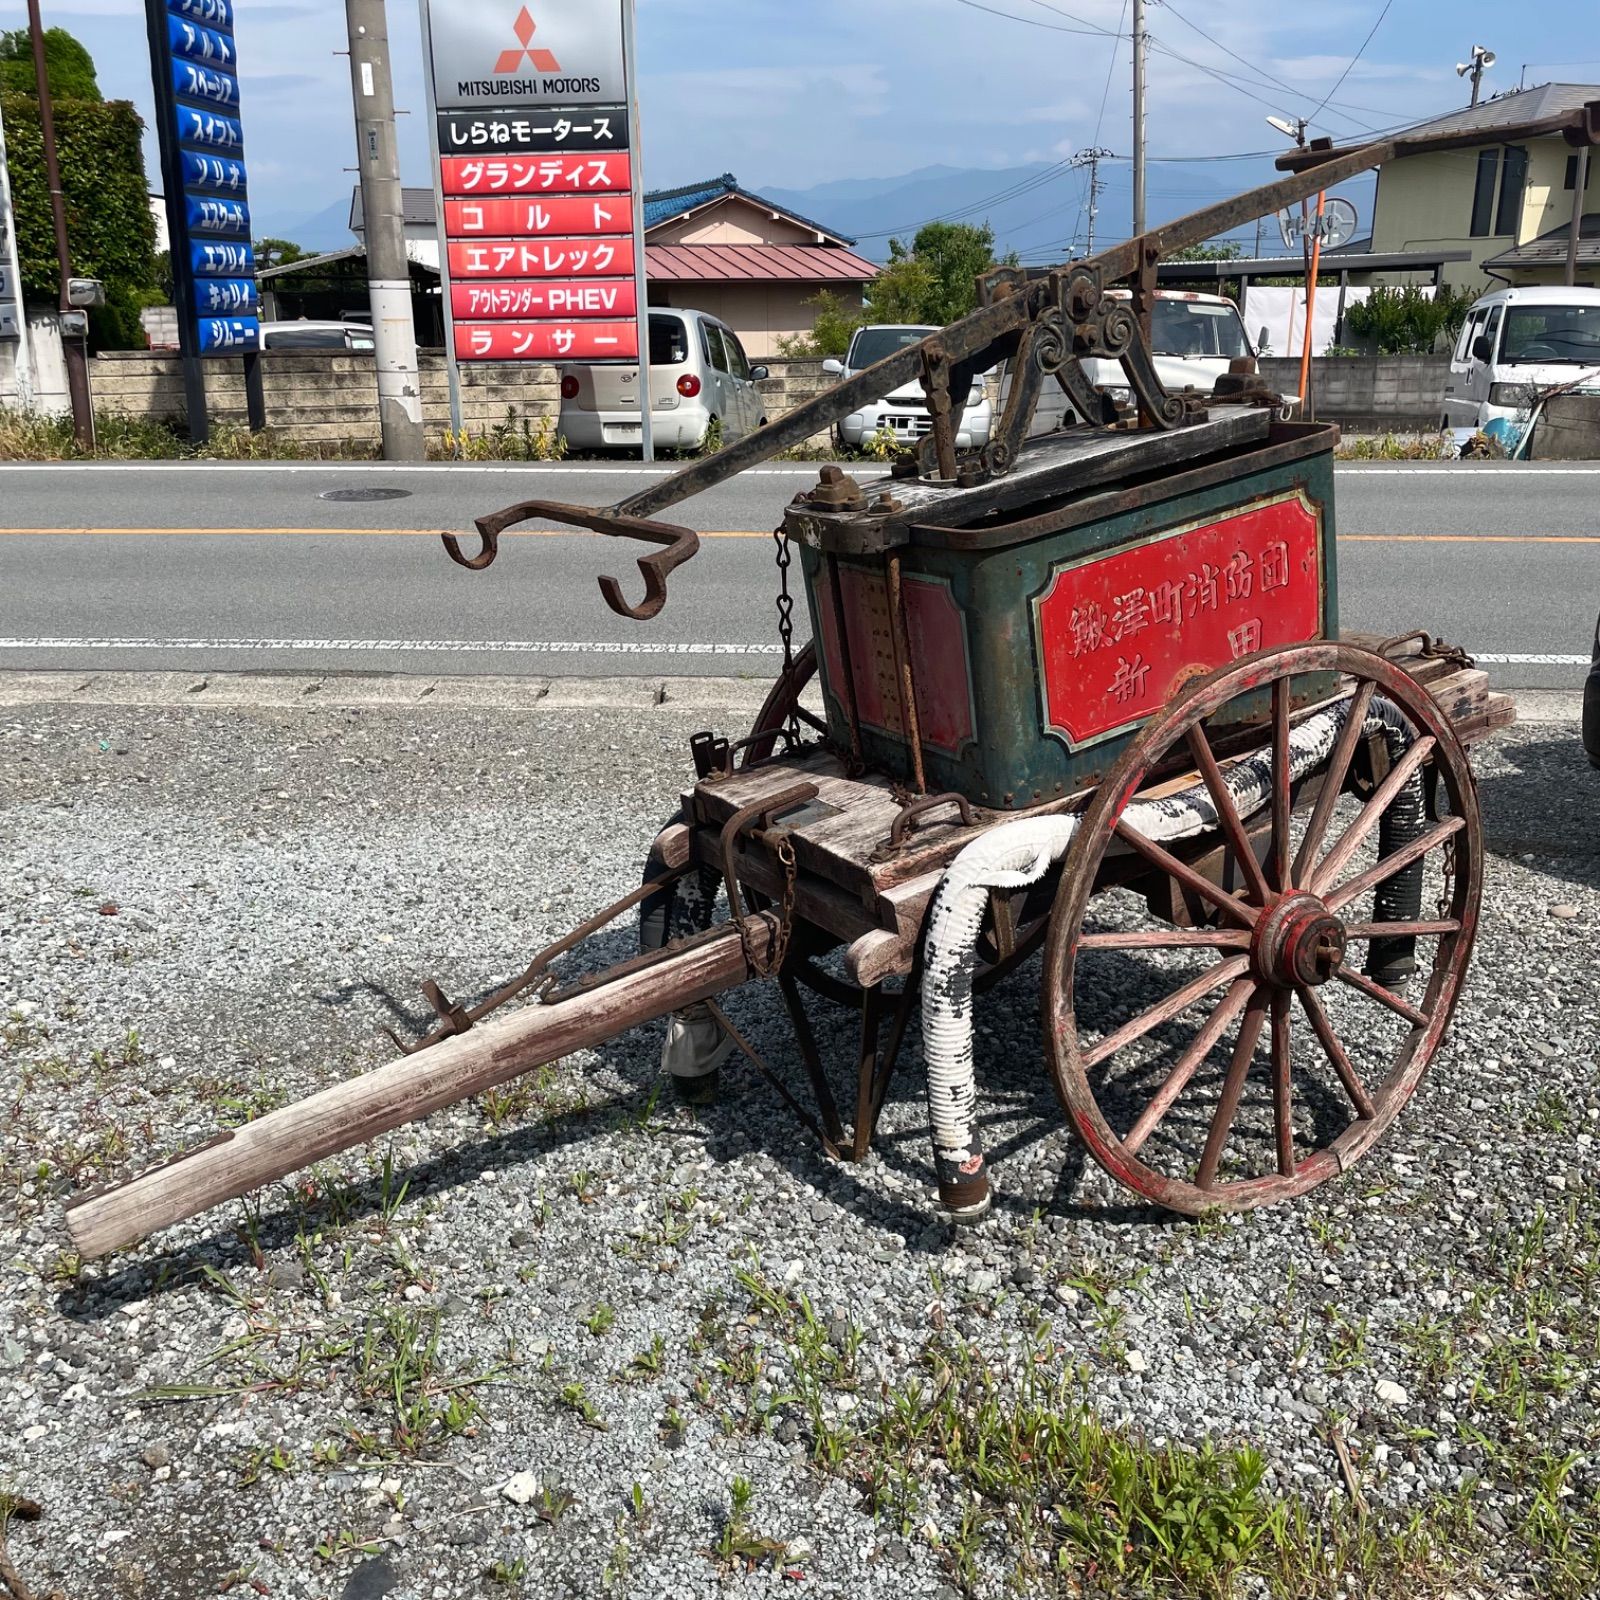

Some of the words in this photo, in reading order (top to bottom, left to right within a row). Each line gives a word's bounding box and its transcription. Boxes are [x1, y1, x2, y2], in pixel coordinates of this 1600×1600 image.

[182, 23, 230, 64] アルト
[458, 79, 538, 96] MITSUBISHI
[543, 77, 600, 94] MOTORS
[191, 112, 237, 147] スイフト
[450, 118, 613, 145] しらねモータース
[196, 158, 240, 190] ソリオ
[460, 160, 612, 189] グランディス
[200, 202, 244, 231] エスクード
[466, 244, 615, 272] エアトレック
[209, 283, 250, 310] キャリイ
[469, 288, 543, 314] アウトランダー
[548, 288, 617, 311] PHEV
[211, 320, 255, 348] ジムニー
[471, 328, 618, 355] ランサー
